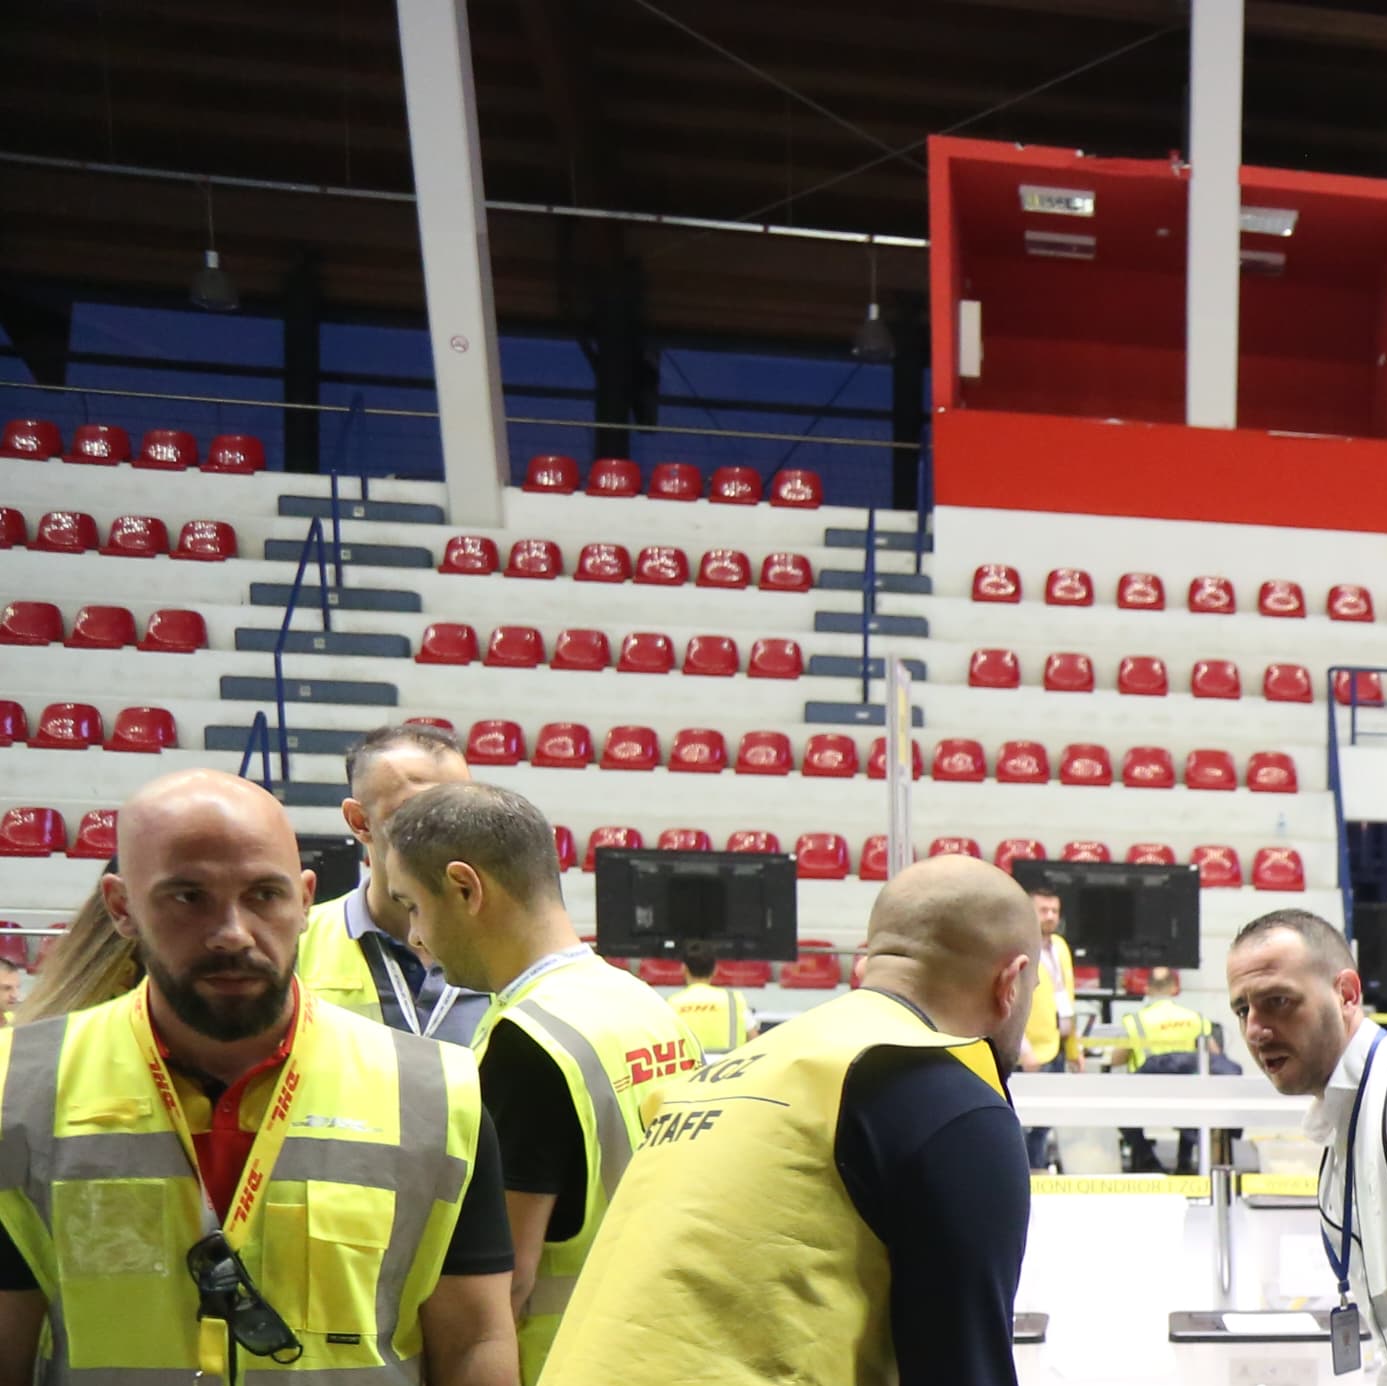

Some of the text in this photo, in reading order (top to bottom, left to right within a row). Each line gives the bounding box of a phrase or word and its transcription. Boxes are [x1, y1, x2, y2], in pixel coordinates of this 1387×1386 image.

[625, 1038, 696, 1085] DHL
[272, 1072, 300, 1121] DHL
[638, 1109, 724, 1151] STAFF
[233, 1170, 264, 1223] DHL
